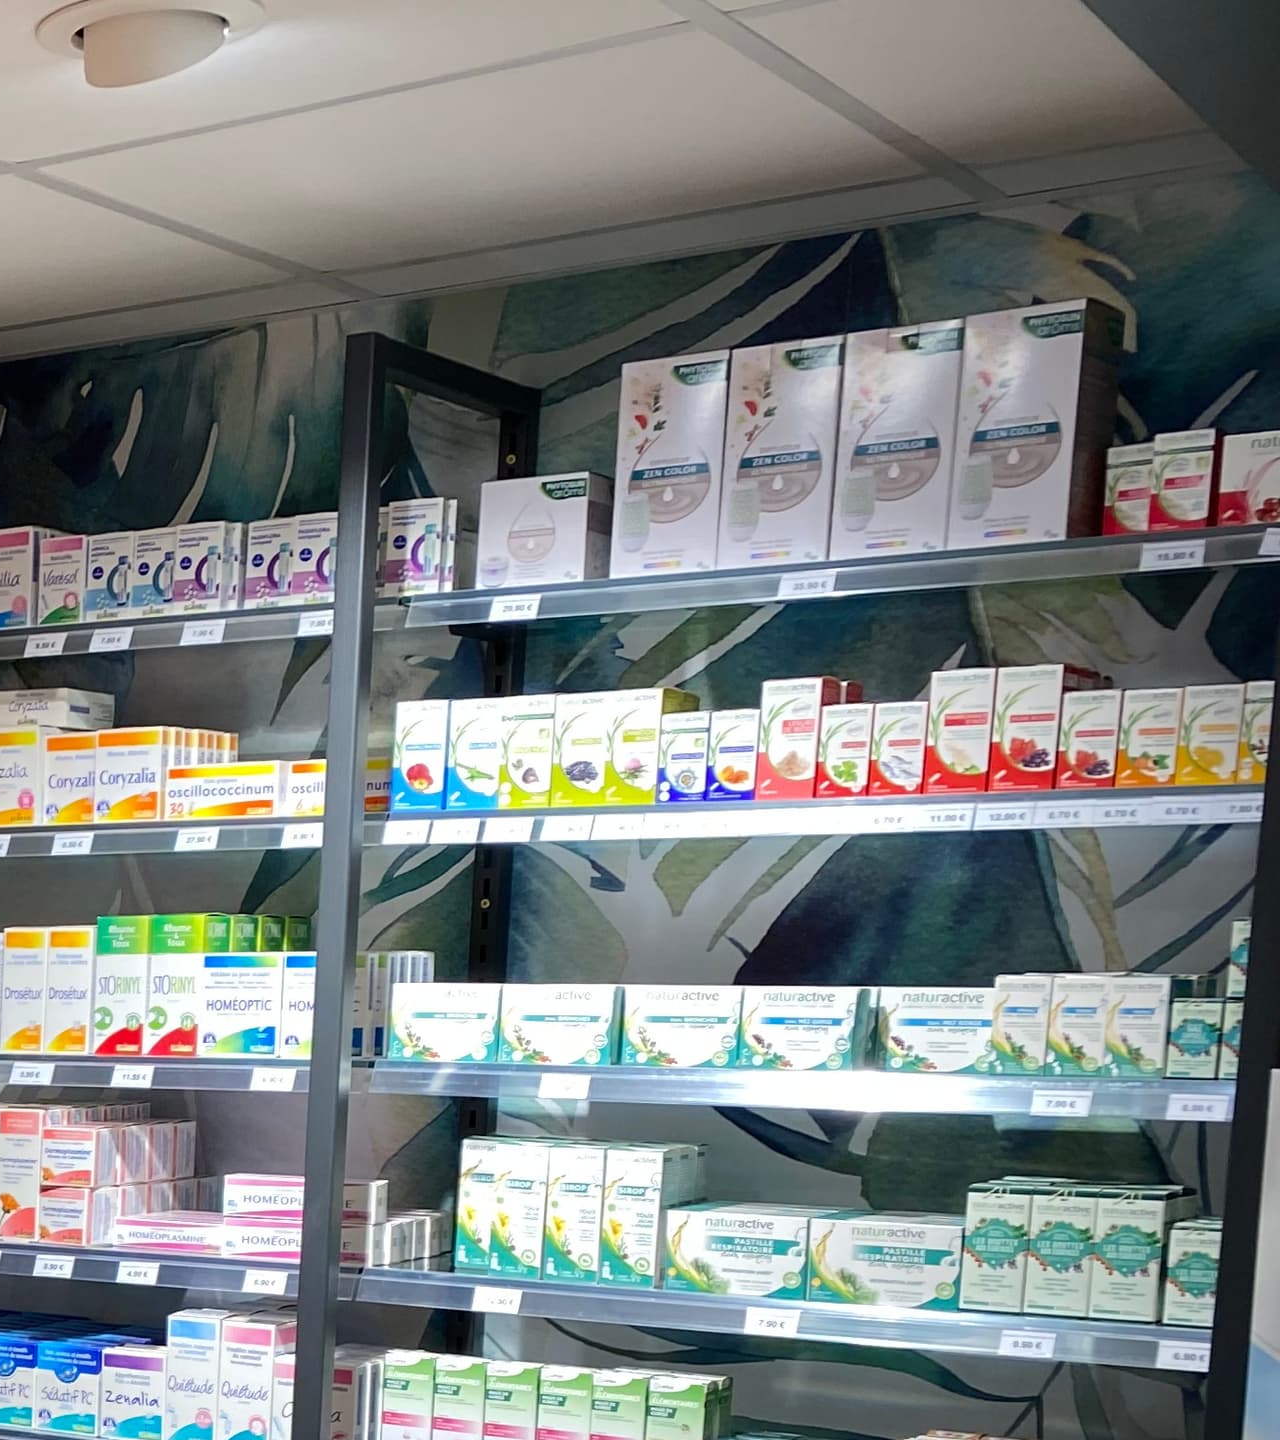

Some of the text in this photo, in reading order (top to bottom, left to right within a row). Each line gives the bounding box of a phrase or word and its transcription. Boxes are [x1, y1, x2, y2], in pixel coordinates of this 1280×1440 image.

[866, 438, 927, 454] ZEN COLOR
[752, 451, 808, 467] ZEN COLOR
[642, 468, 664, 478] ZEN
[48, 772, 95, 790] Coryzali
[99, 767, 156, 789] Coryzalia
[168, 782, 274, 798] oscillococcinum
[763, 990, 836, 1003] naturactive
[902, 991, 984, 1005] naturactive
[206, 996, 272, 1012] HOMÉOPTIC
[704, 1218, 775, 1231] naturactive
[851, 1227, 926, 1241] naturactive
[734, 1238, 775, 1247] PASTILLE
[883, 1246, 926, 1256] PASTILLE
[18, 1384, 32, 1398] PC
[220, 1380, 269, 1401] Quiétude
[80, 1391, 94, 1405] PC
[104, 1390, 160, 1408] Zenalia
